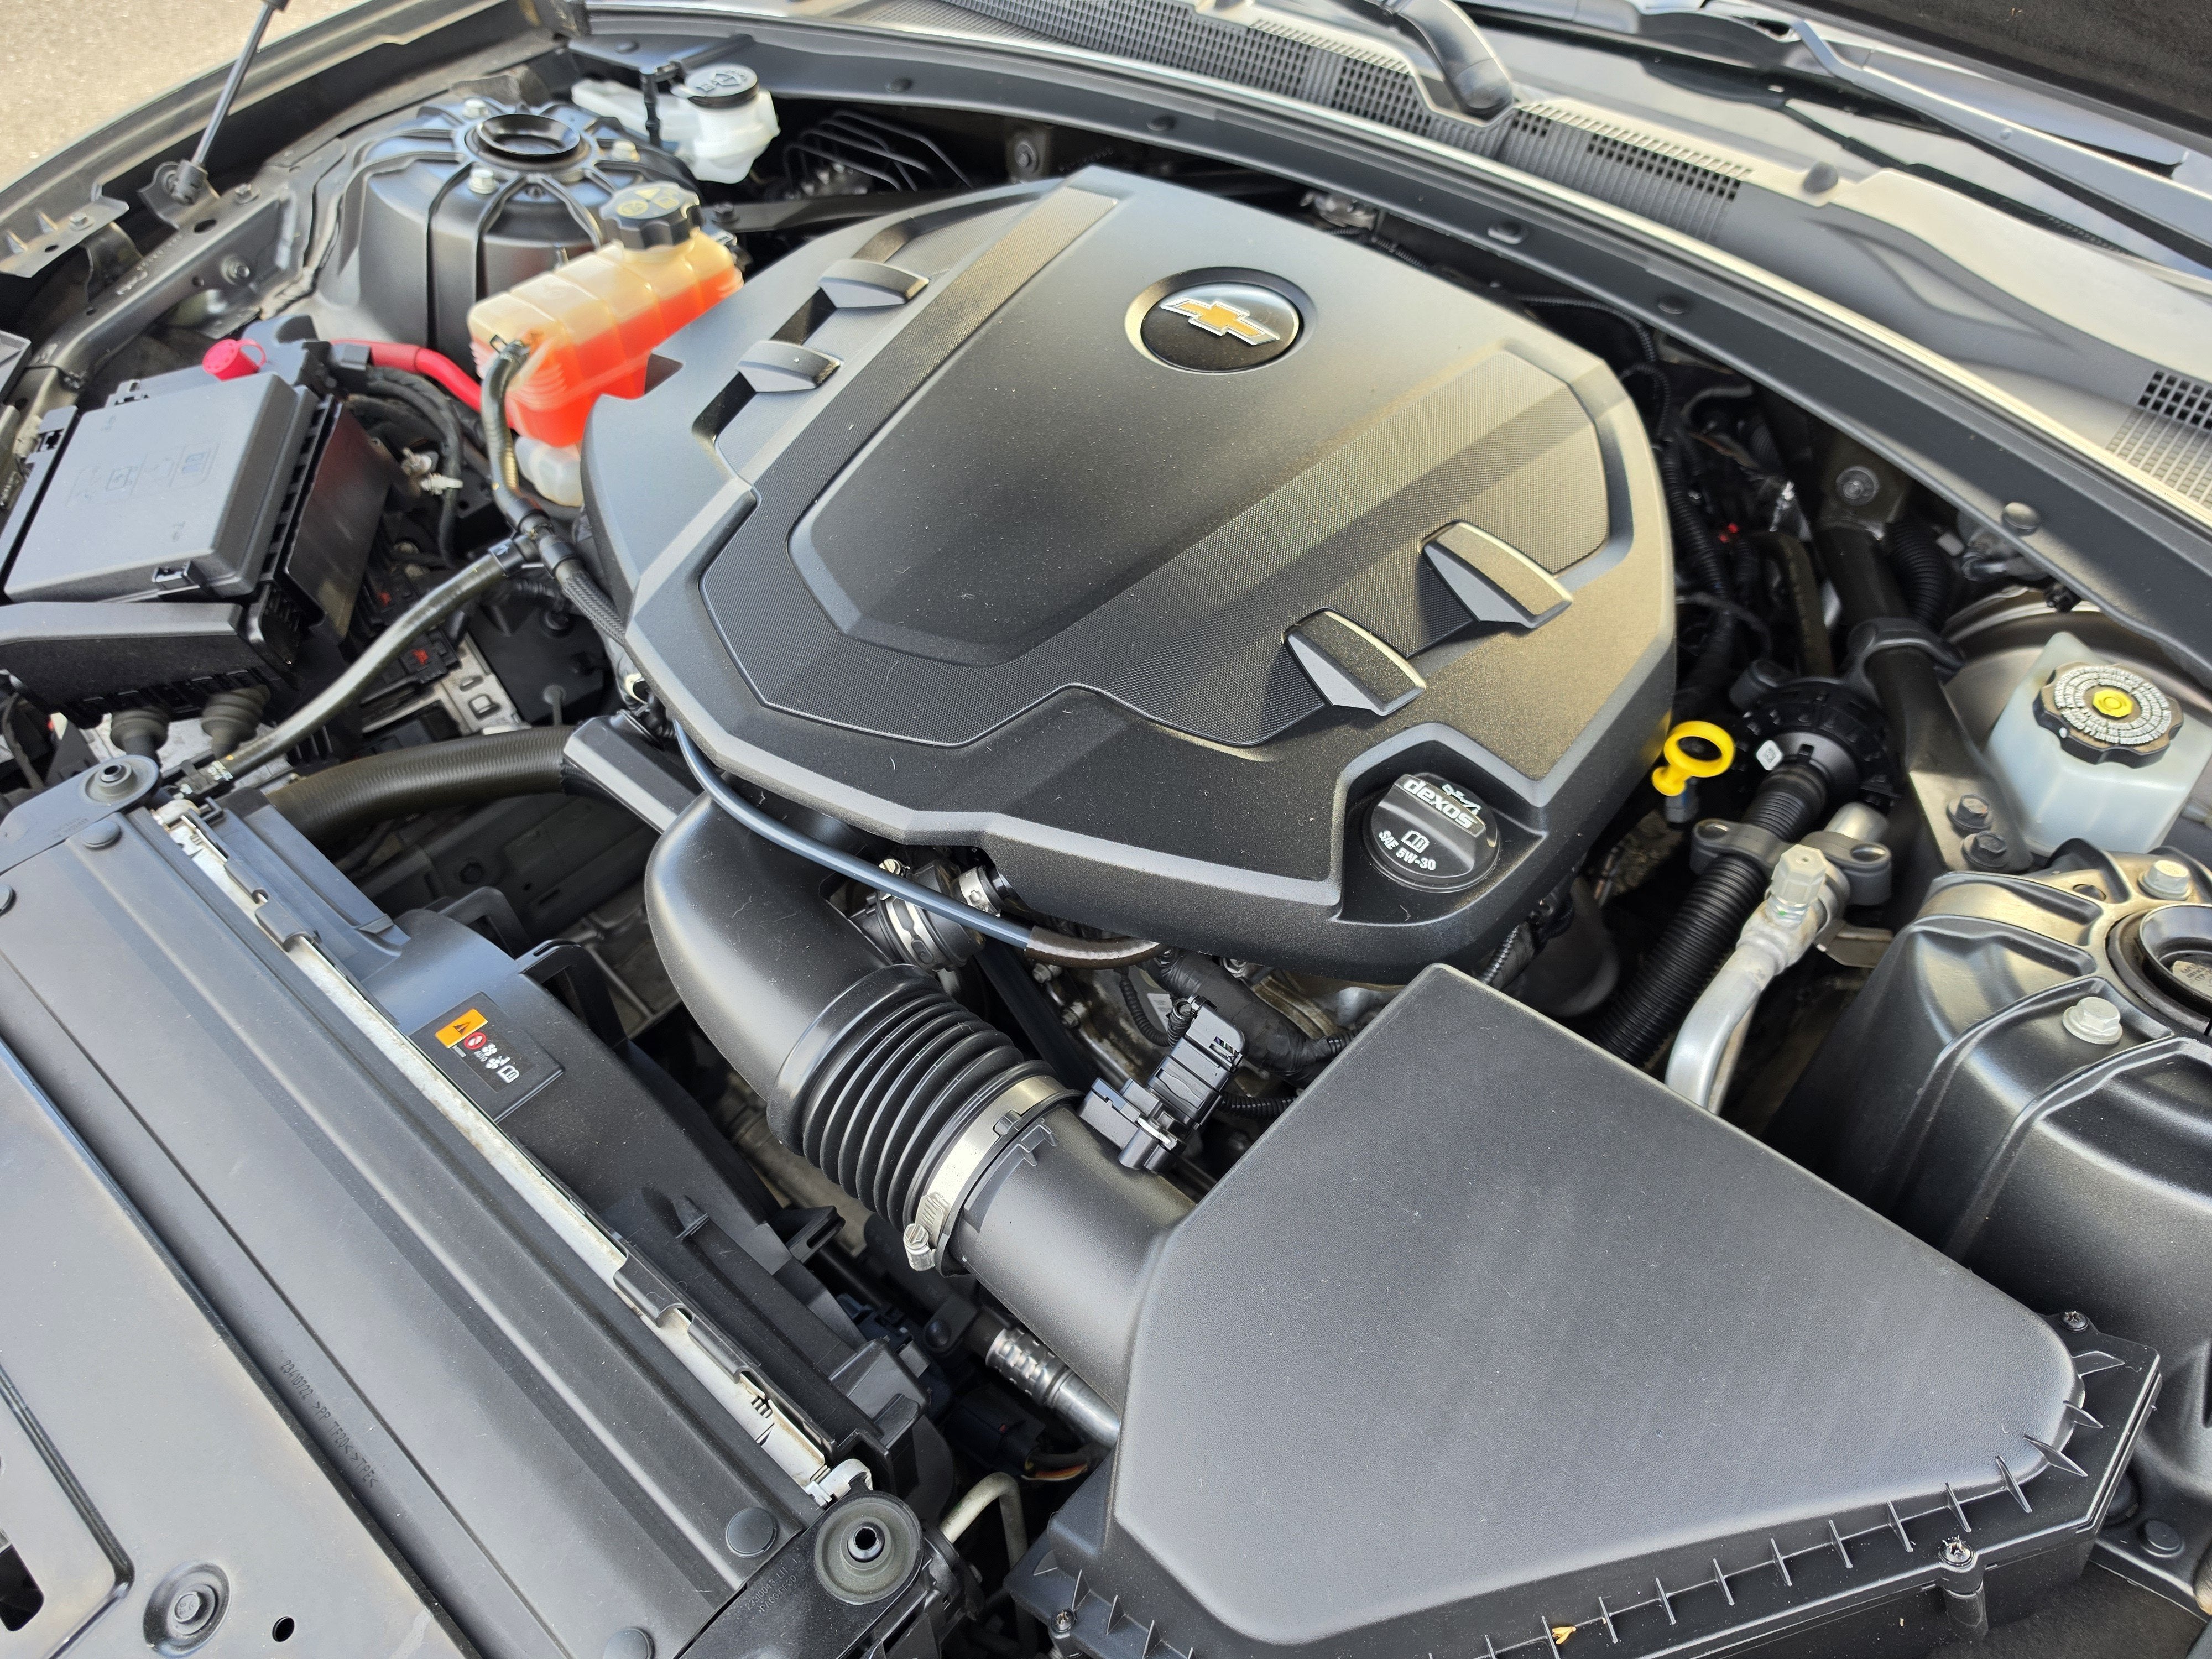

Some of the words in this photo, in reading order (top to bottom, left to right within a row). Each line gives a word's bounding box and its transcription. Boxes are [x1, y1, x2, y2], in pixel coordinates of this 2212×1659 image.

[1403, 780, 1475, 828] dexos
[1379, 830, 1399, 850] SAE
[1396, 848, 1436, 870] 5W-30
[281, 1360, 314, 1400] 23410722
